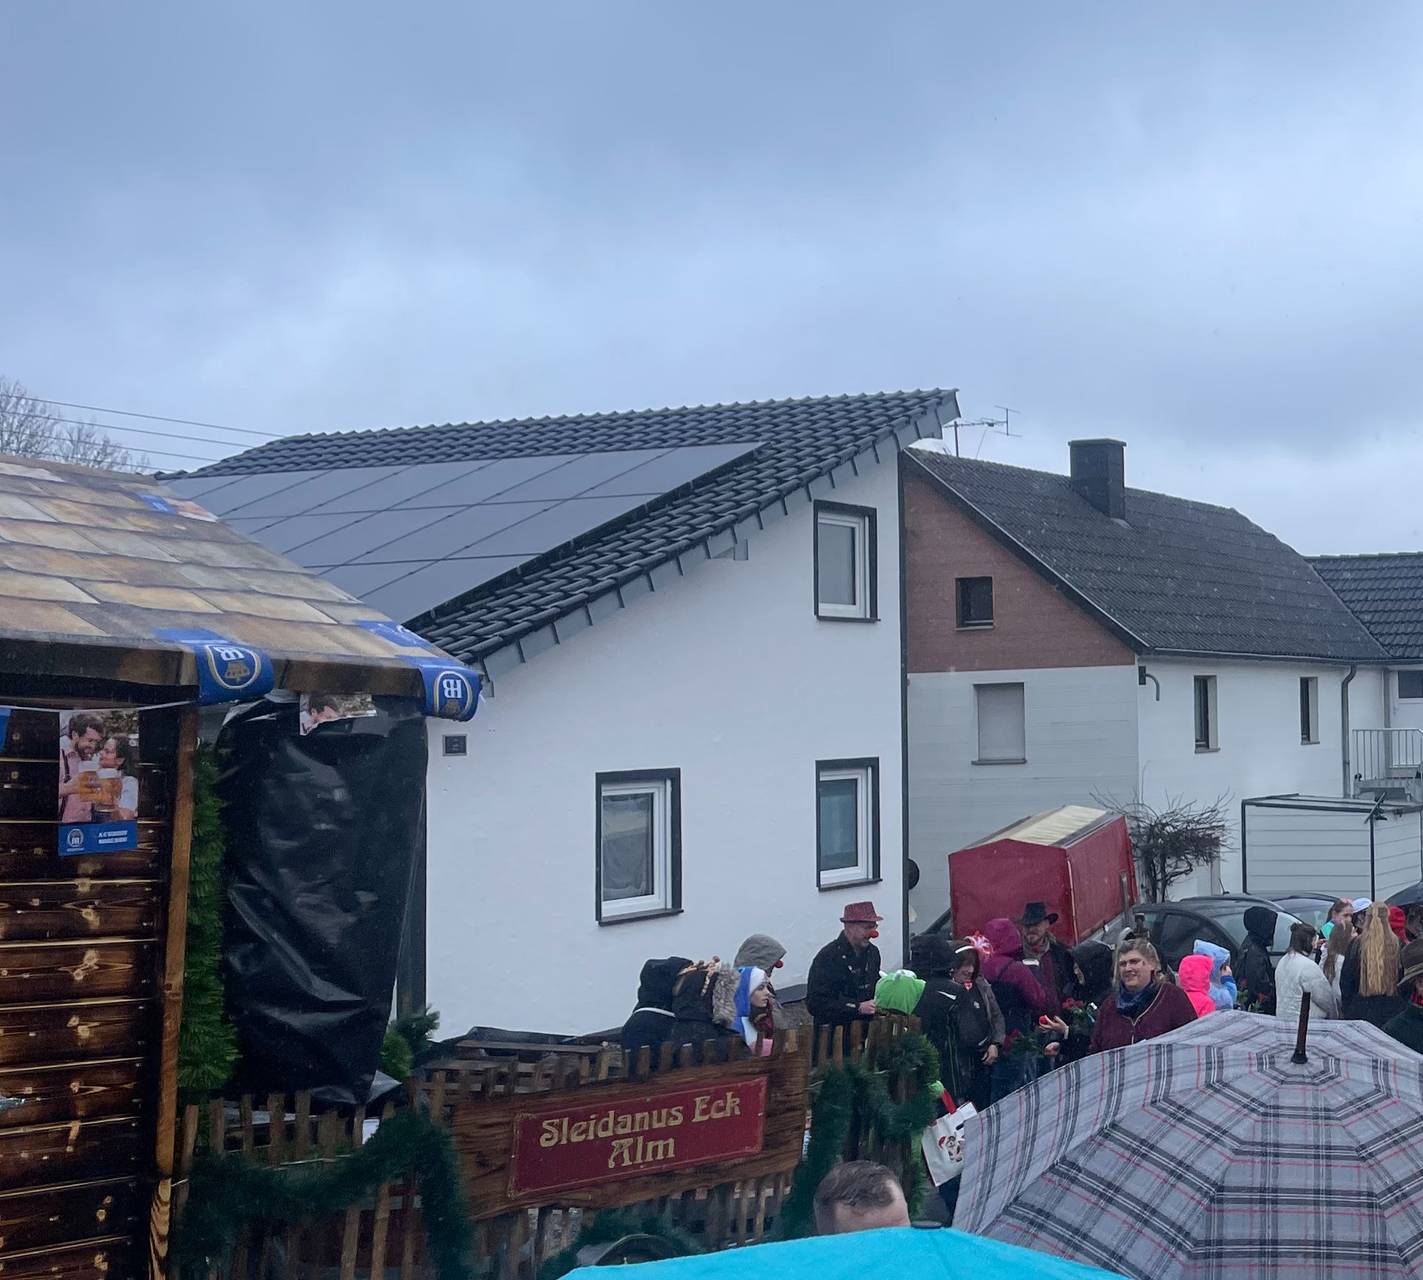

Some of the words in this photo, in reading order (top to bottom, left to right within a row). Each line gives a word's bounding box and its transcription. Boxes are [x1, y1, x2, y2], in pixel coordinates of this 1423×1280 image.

[442, 678, 462, 699] HB
[539, 1106, 684, 1148] Sleidanus
[691, 1090, 742, 1123] Eck
[607, 1136, 676, 1169] Alm
